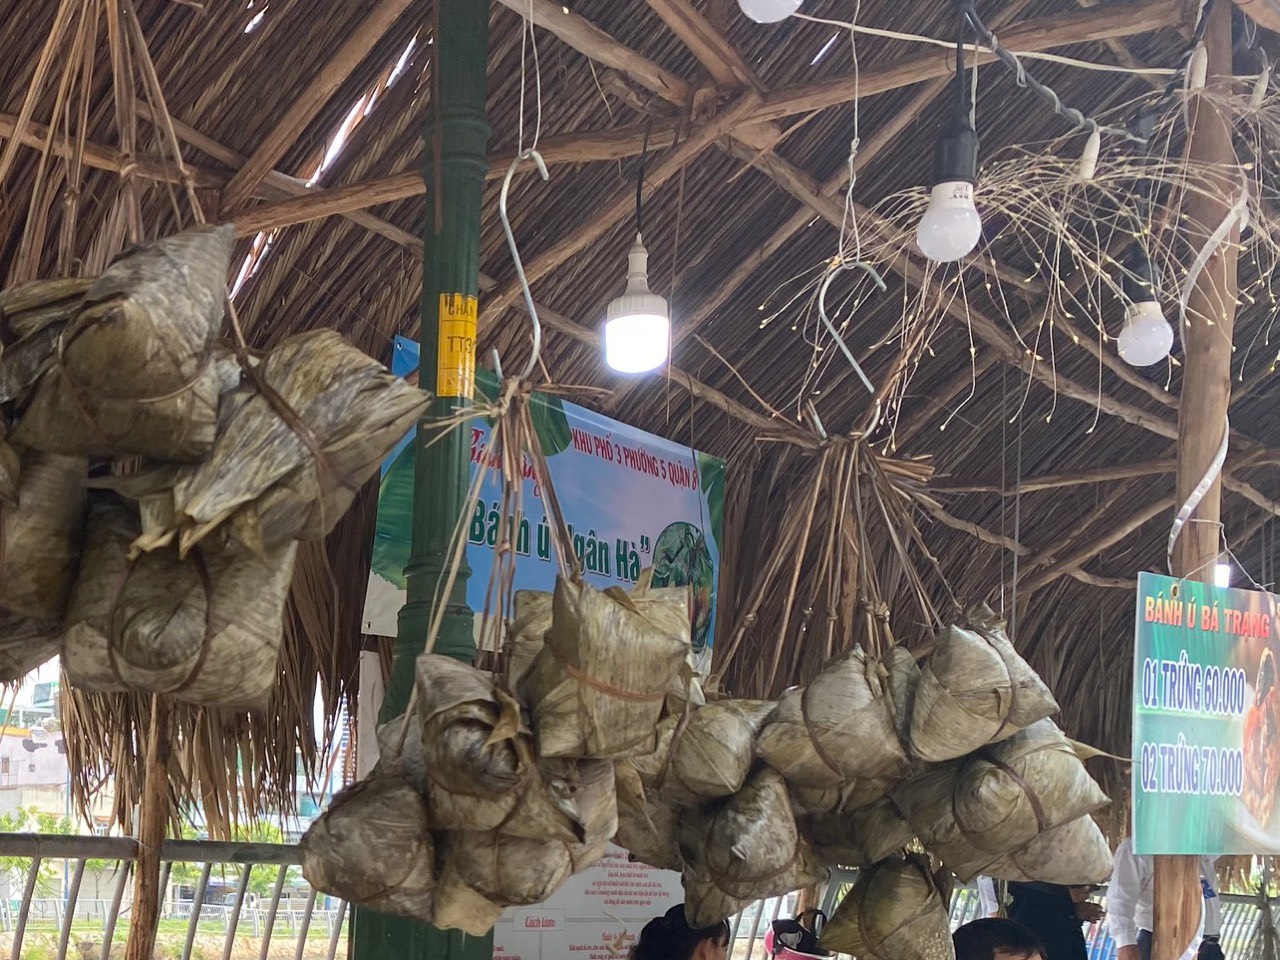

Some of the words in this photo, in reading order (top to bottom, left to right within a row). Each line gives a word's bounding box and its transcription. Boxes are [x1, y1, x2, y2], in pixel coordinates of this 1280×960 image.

[572, 428, 592, 454] KHU
[594, 433, 613, 462] PHỐ
[623, 445, 659, 477] PHƯỜNG
[661, 461, 666, 479] 5
[669, 462, 690, 489] QUẬN
[692, 469, 698, 490] 8
[1144, 590, 1182, 627] BÁNH
[1186, 597, 1197, 629] Ú
[1201, 600, 1219, 632] BÁ
[1224, 609, 1270, 643] TRẠNG
[1143, 658, 1158, 709] 01
[1161, 650, 1202, 712] TRỨNG
[1203, 663, 1247, 715] 60.000
[1141, 742, 1157, 793] 02
[1158, 733, 1200, 796] TRỨNG
[1201, 744, 1244, 796] 70.000
